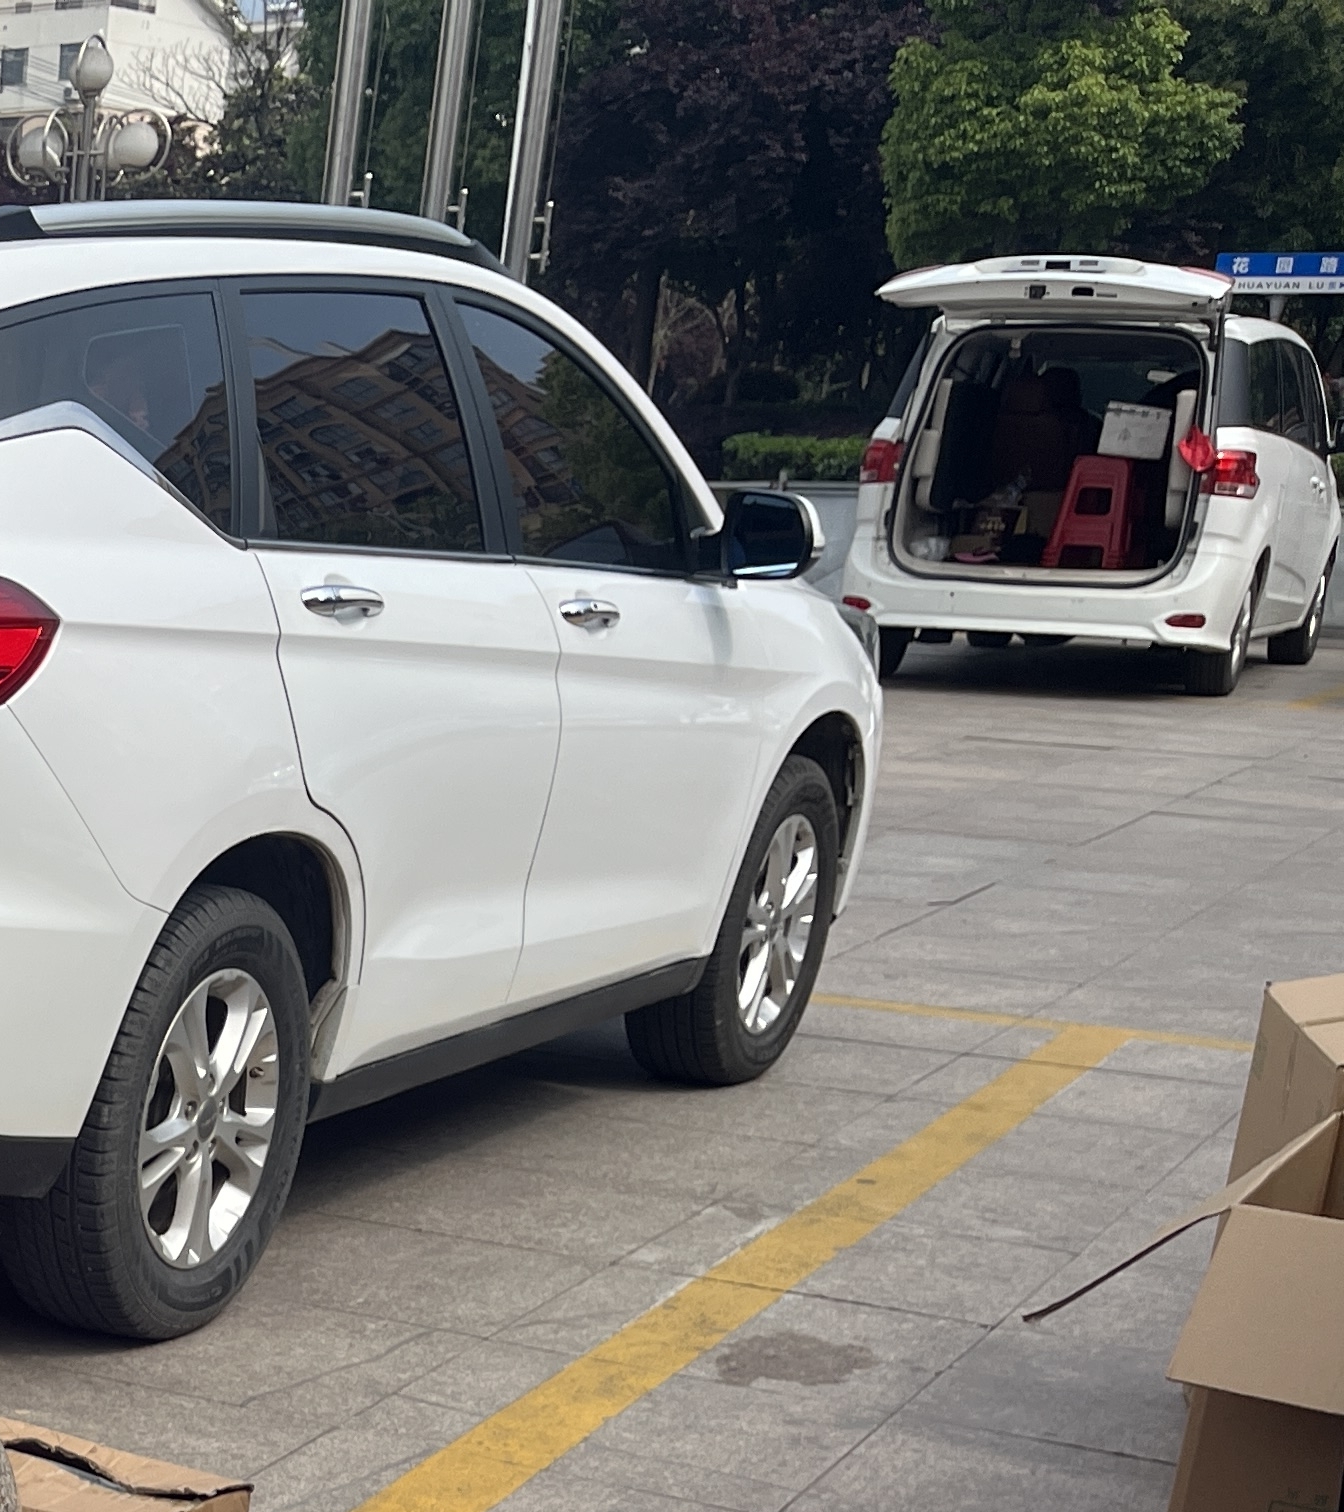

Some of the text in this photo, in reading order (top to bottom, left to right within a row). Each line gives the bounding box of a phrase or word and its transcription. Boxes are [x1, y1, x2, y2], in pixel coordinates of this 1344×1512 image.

[1231, 256, 1339, 275] 花园路
[1237, 281, 1301, 290] HUAYUAN
[1308, 281, 1325, 290] LU
